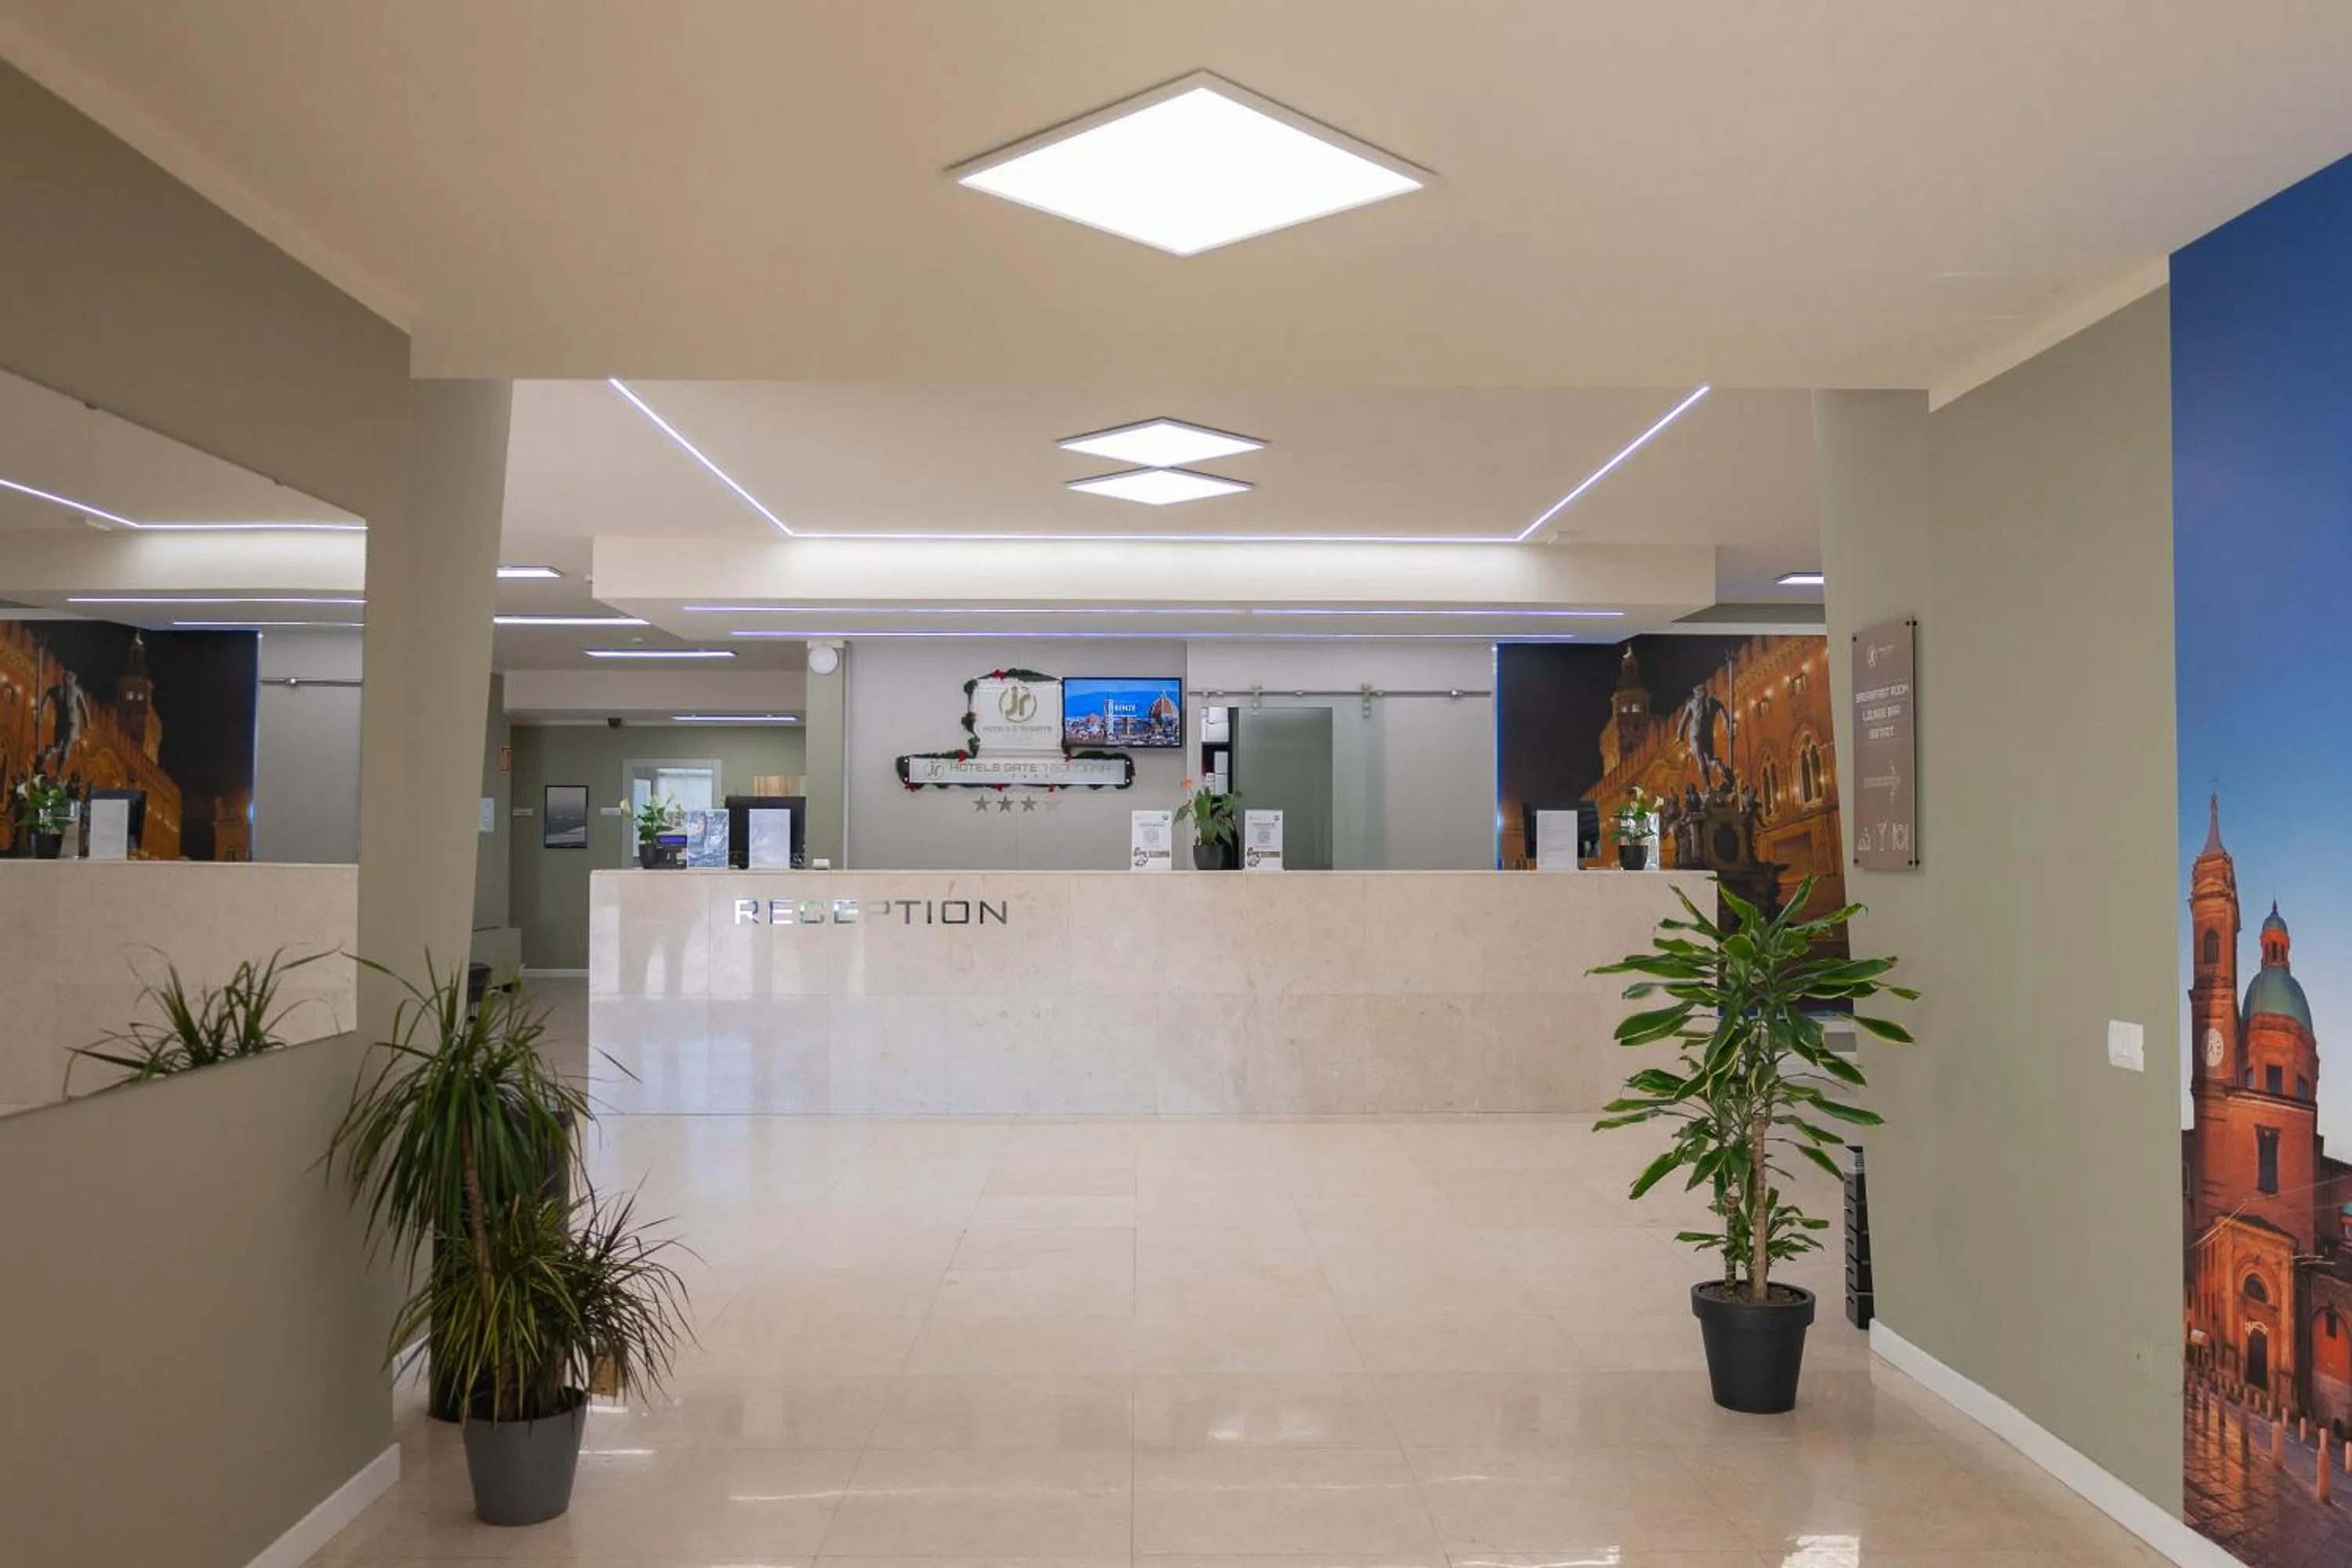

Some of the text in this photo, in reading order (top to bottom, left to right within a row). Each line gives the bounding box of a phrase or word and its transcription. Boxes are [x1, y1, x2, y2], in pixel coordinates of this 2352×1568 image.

[949, 761, 1000, 772] HOTELS
[1004, 763, 1038, 772] GATE
[735, 899, 1007, 925] RECEPTION
